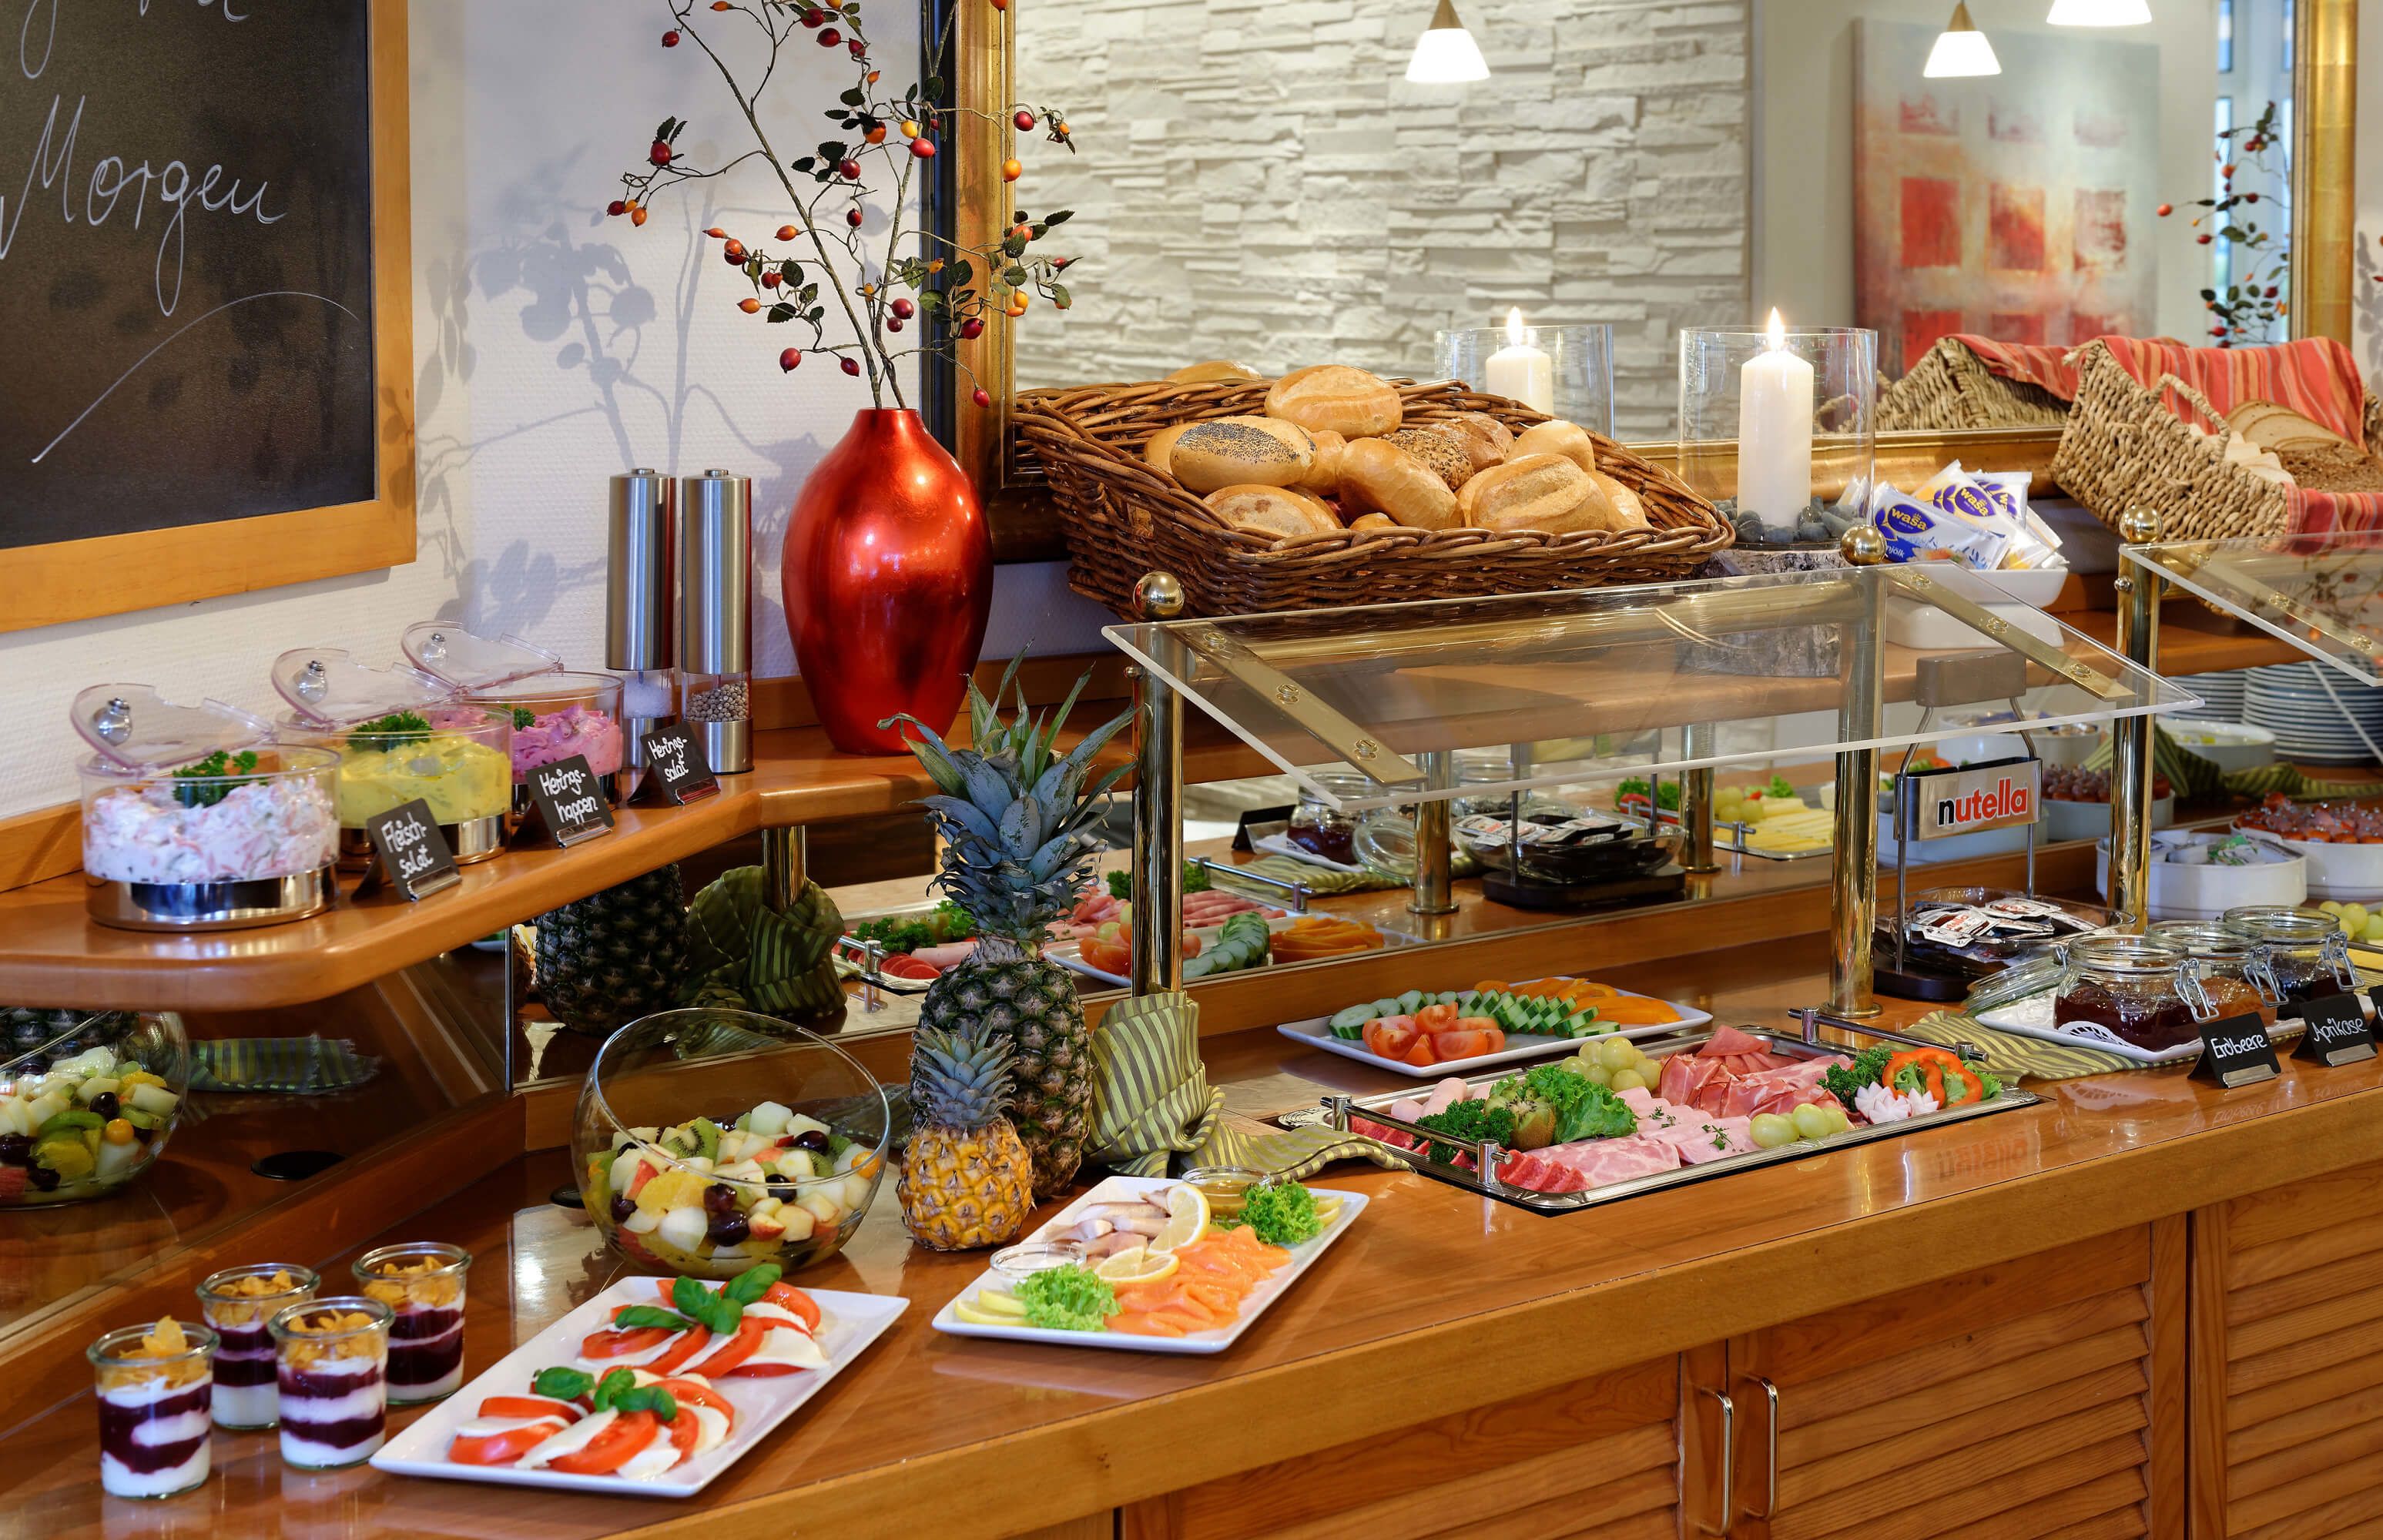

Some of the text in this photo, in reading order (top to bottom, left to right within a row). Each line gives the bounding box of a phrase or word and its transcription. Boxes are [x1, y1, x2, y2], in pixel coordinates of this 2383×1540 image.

[1960, 487, 1989, 517] wasa
[1891, 507, 1928, 531] wasa
[664, 758, 689, 783] salat
[554, 795, 598, 825] happen
[1937, 775, 2028, 827] nutella
[398, 843, 434, 879] salat
[2311, 1016, 2368, 1044] Aprikose
[2210, 1033, 2268, 1060] Erdbeere
